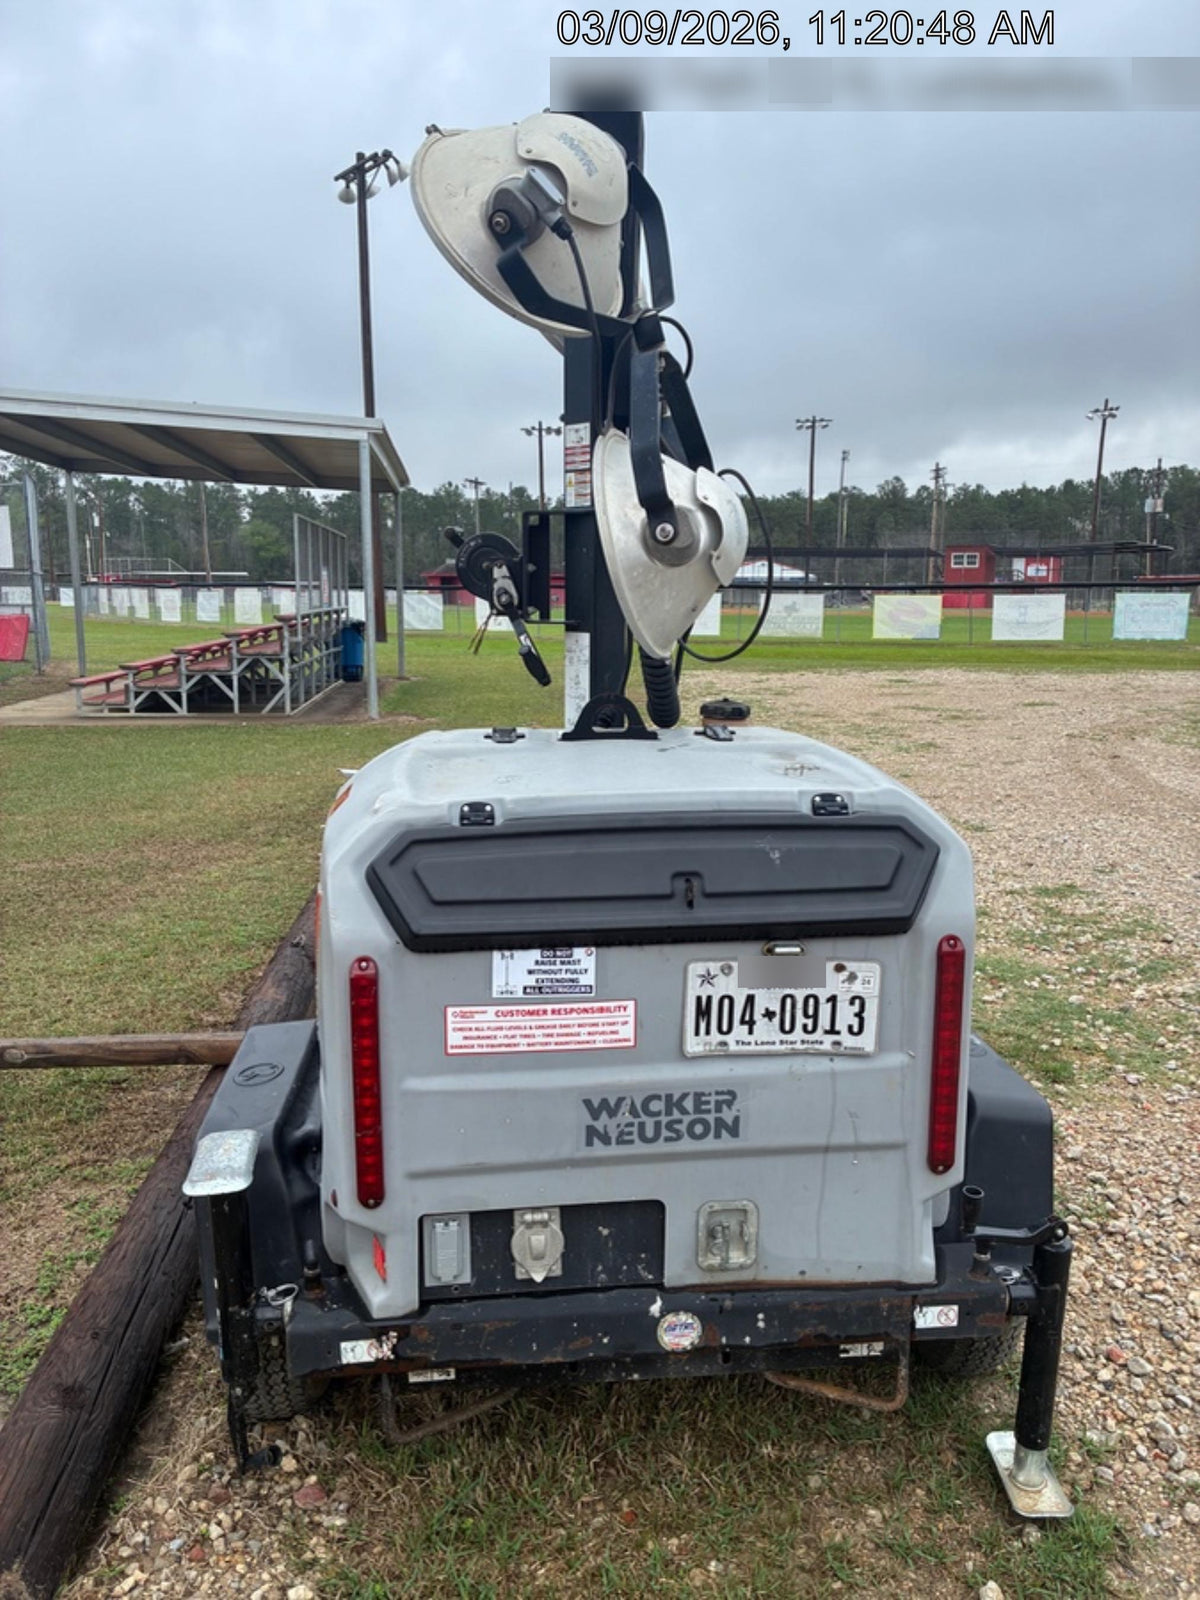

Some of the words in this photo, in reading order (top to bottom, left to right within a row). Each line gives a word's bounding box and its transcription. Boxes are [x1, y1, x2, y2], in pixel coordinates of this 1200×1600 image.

[525, 986, 540, 994] ALL
[494, 1008, 549, 1018] CUSTOMER
[550, 1005, 629, 1016] RESPONSIBILITY
[800, 1038, 824, 1046] State
[582, 1089, 738, 1121] WACKER
[585, 1115, 741, 1147] NEUSON
